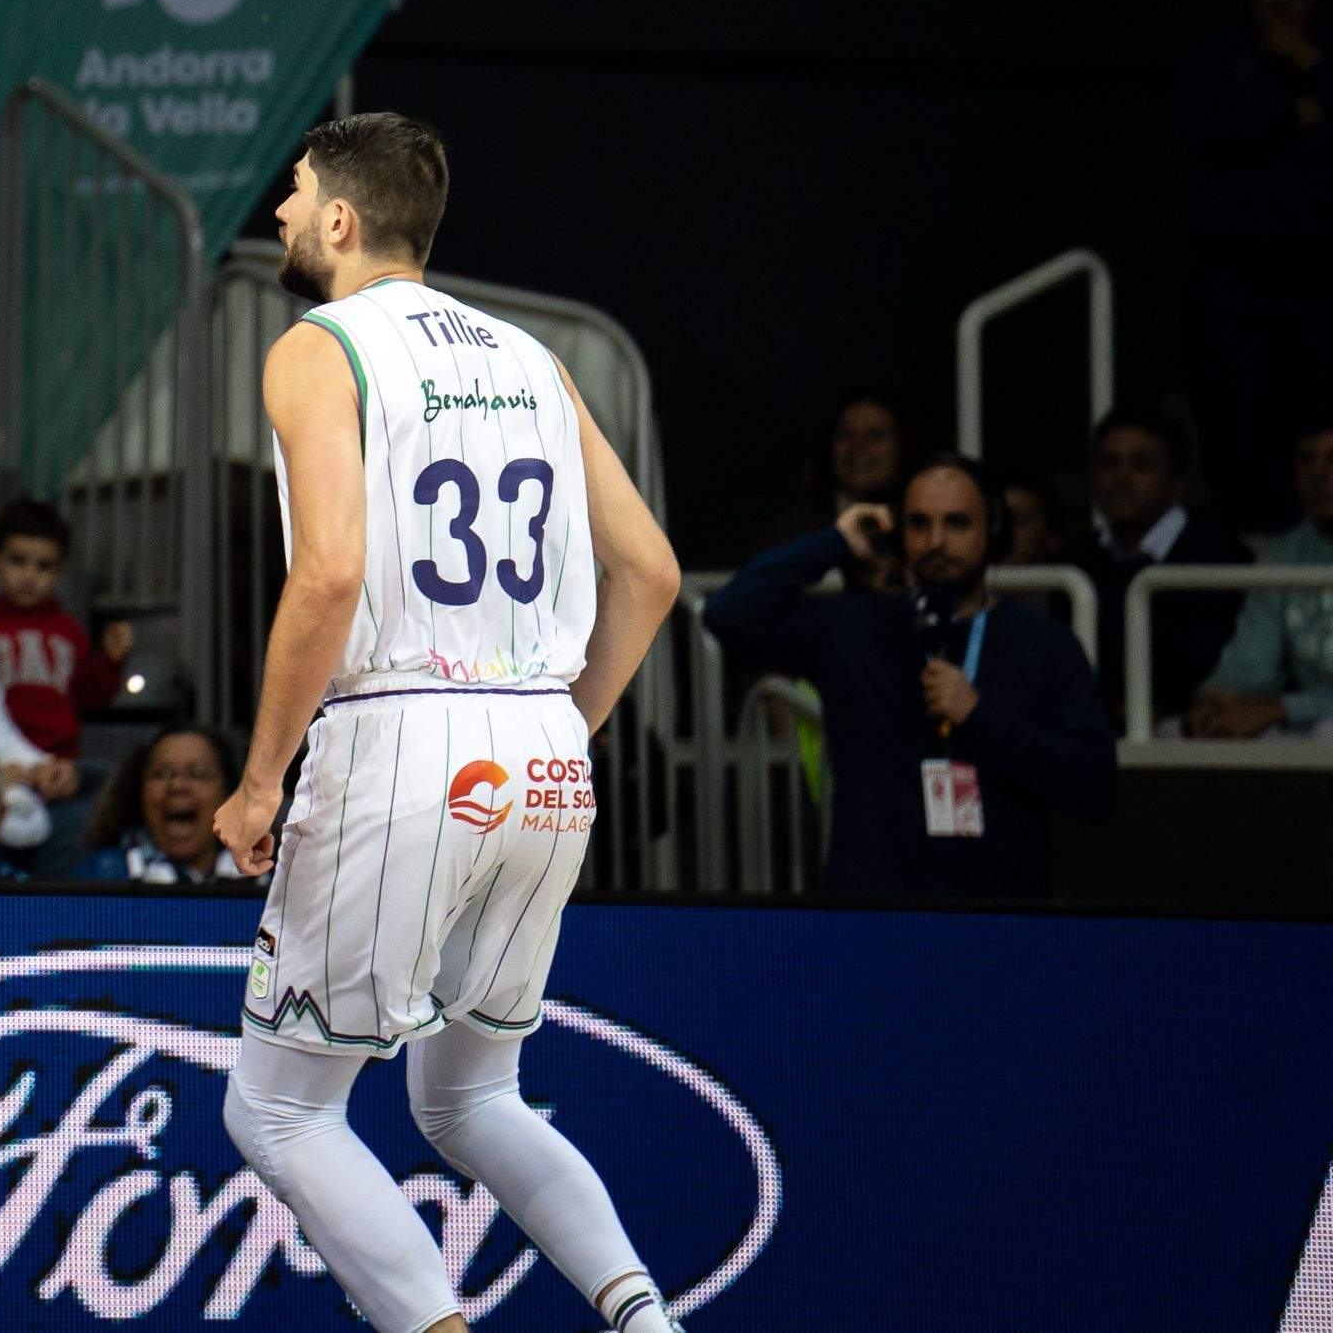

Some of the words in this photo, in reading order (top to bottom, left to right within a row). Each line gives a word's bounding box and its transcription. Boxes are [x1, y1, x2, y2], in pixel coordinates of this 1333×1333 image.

[77, 43, 273, 87] Andorra
[139, 91, 260, 135] Vella
[406, 308, 499, 349] Tillie
[412, 458, 554, 606] 33
[527, 758, 592, 784] COST
[524, 789, 569, 809] DEL
[521, 810, 593, 834] MÁLAG
